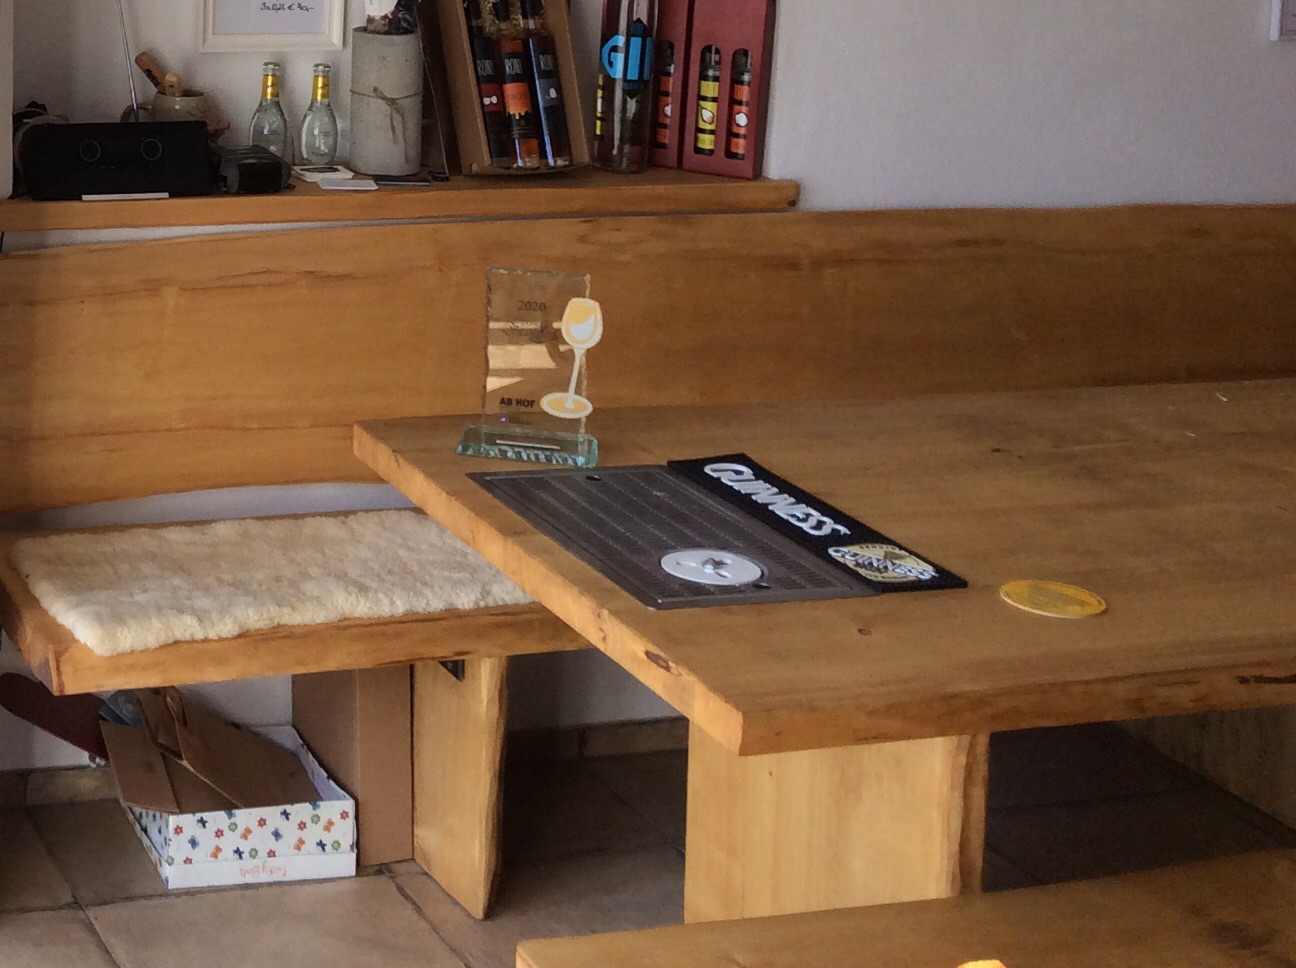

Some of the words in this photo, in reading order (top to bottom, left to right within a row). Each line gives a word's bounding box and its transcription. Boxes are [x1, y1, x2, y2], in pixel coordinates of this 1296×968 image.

[517, 299, 547, 312] 2020
[499, 397, 513, 406] AB
[516, 399, 536, 408] HOF
[704, 462, 852, 536] GUINNESS
